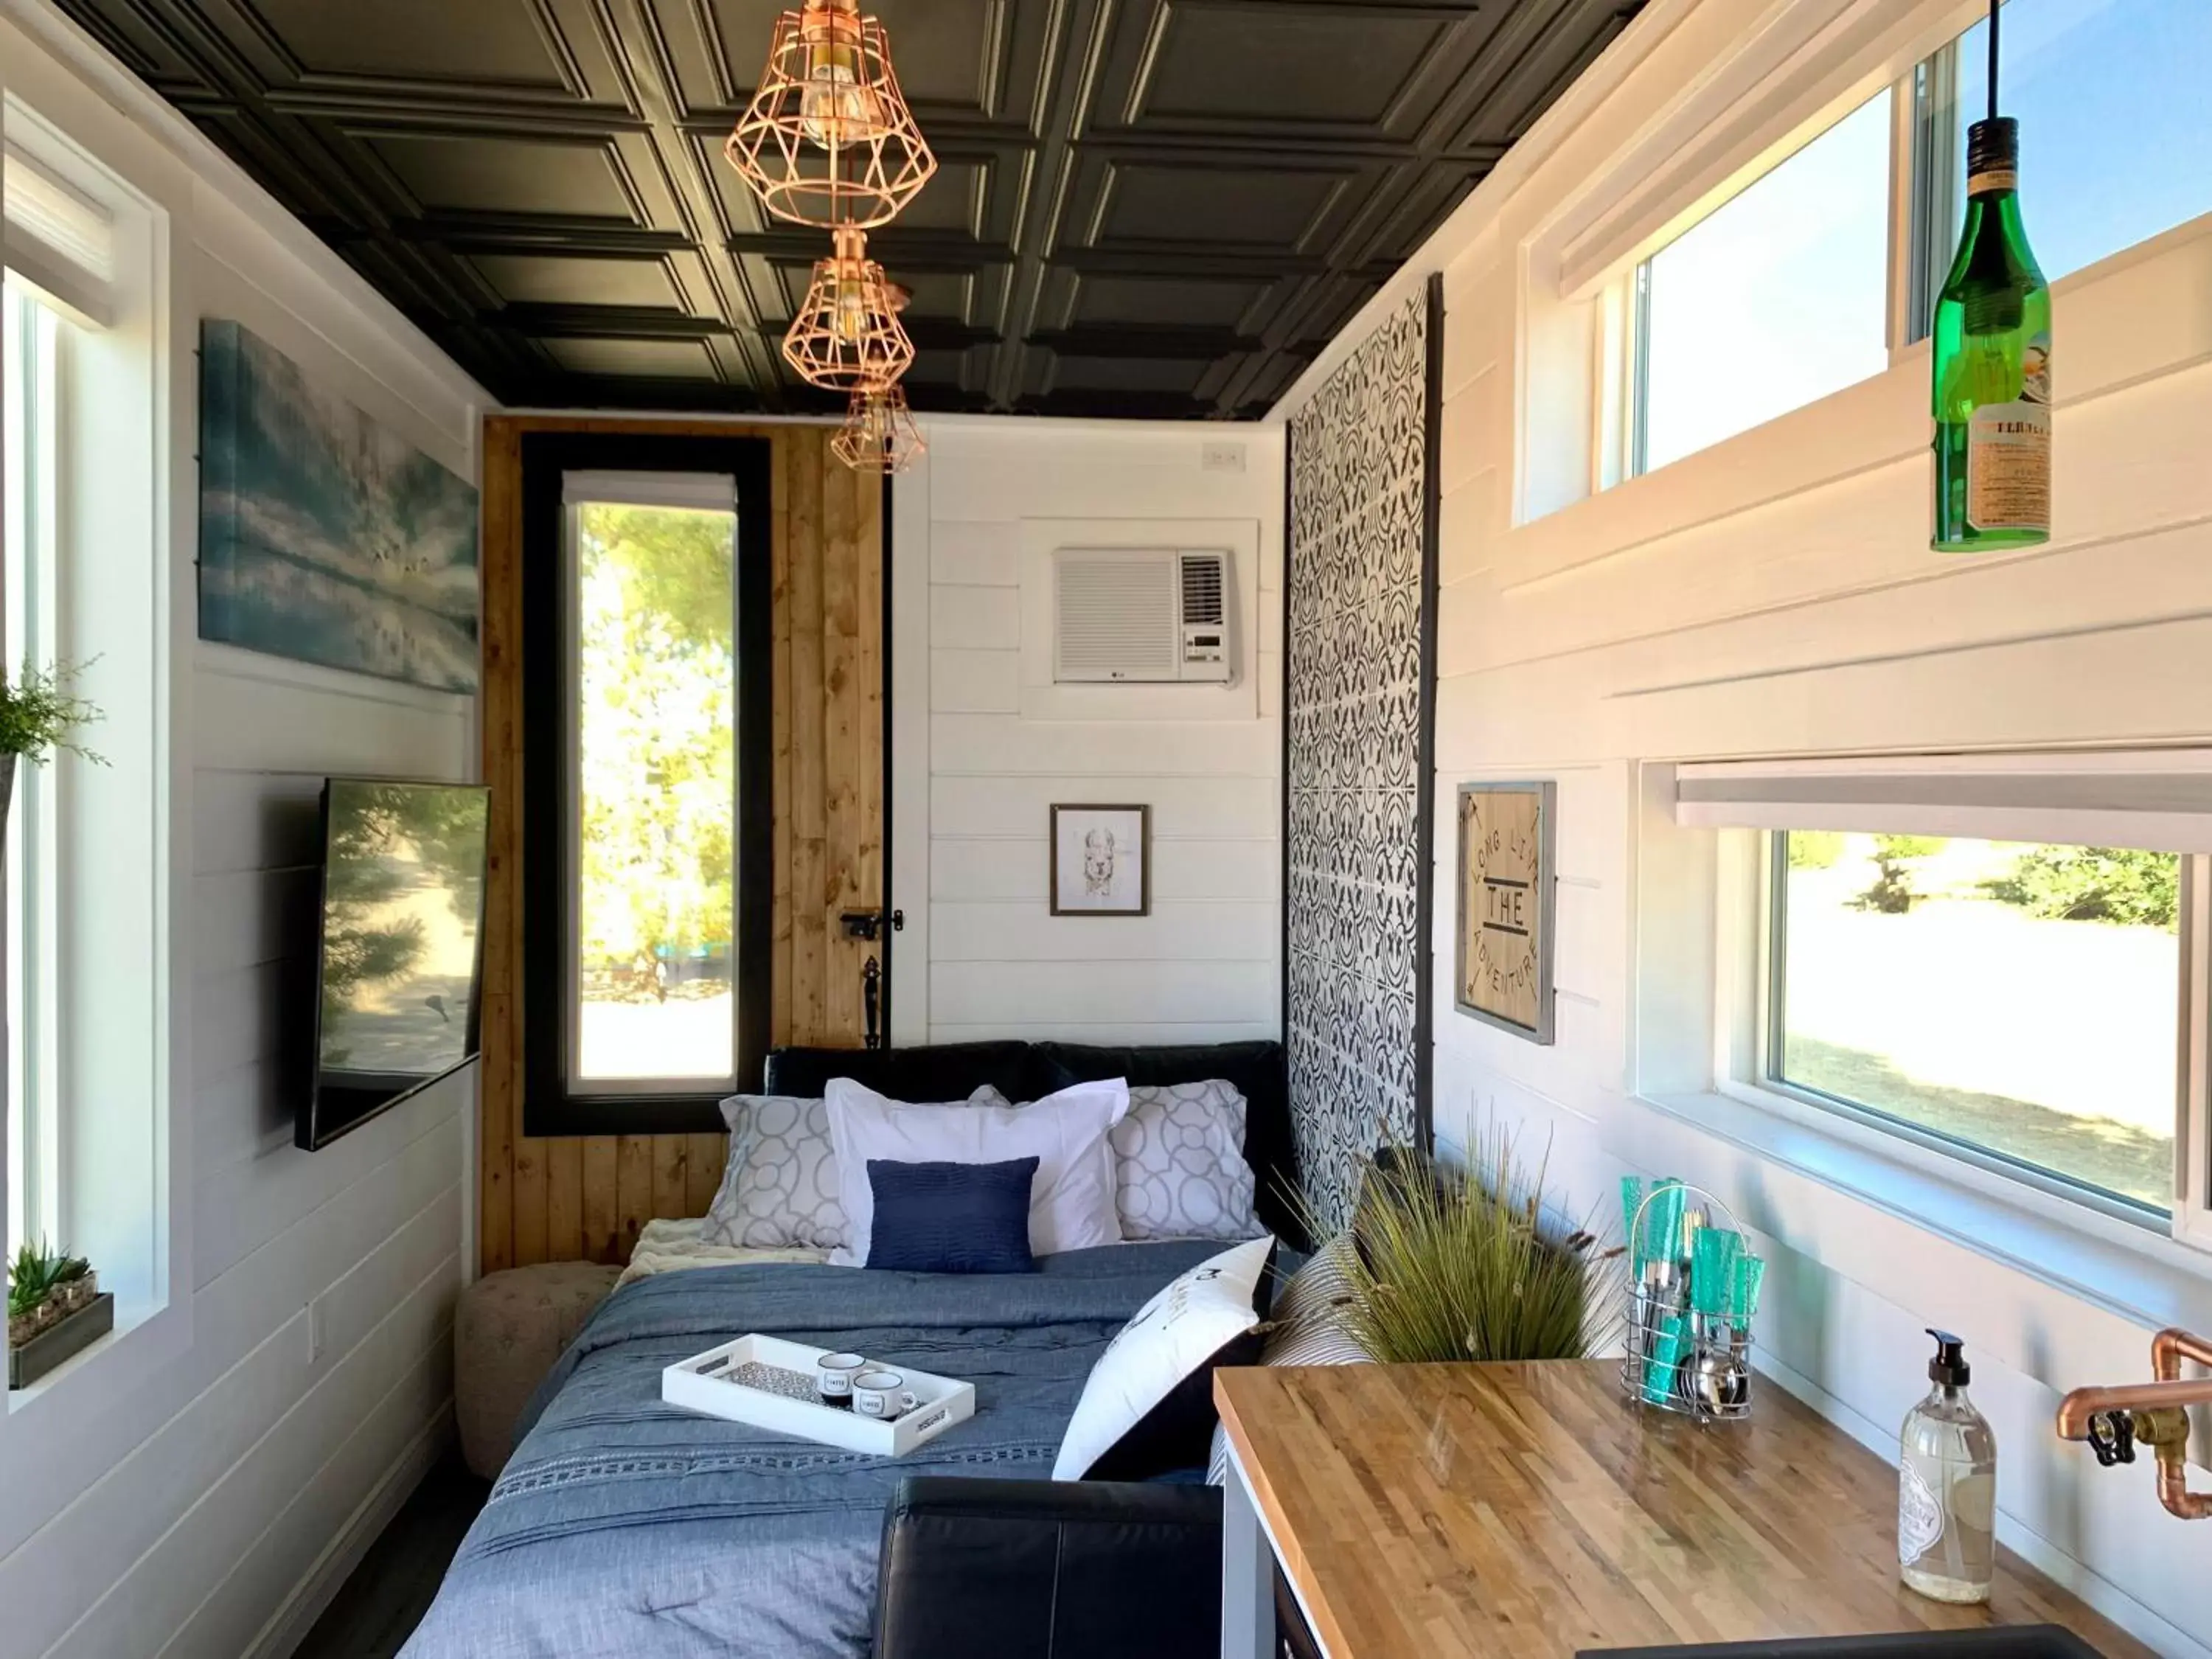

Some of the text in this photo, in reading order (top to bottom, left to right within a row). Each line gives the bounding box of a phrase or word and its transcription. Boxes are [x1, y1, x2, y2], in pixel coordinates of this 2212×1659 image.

[1472, 829, 1500, 884] LONG
[1487, 886, 1523, 925] THE
[1474, 930, 1537, 994] ADVENTURE
